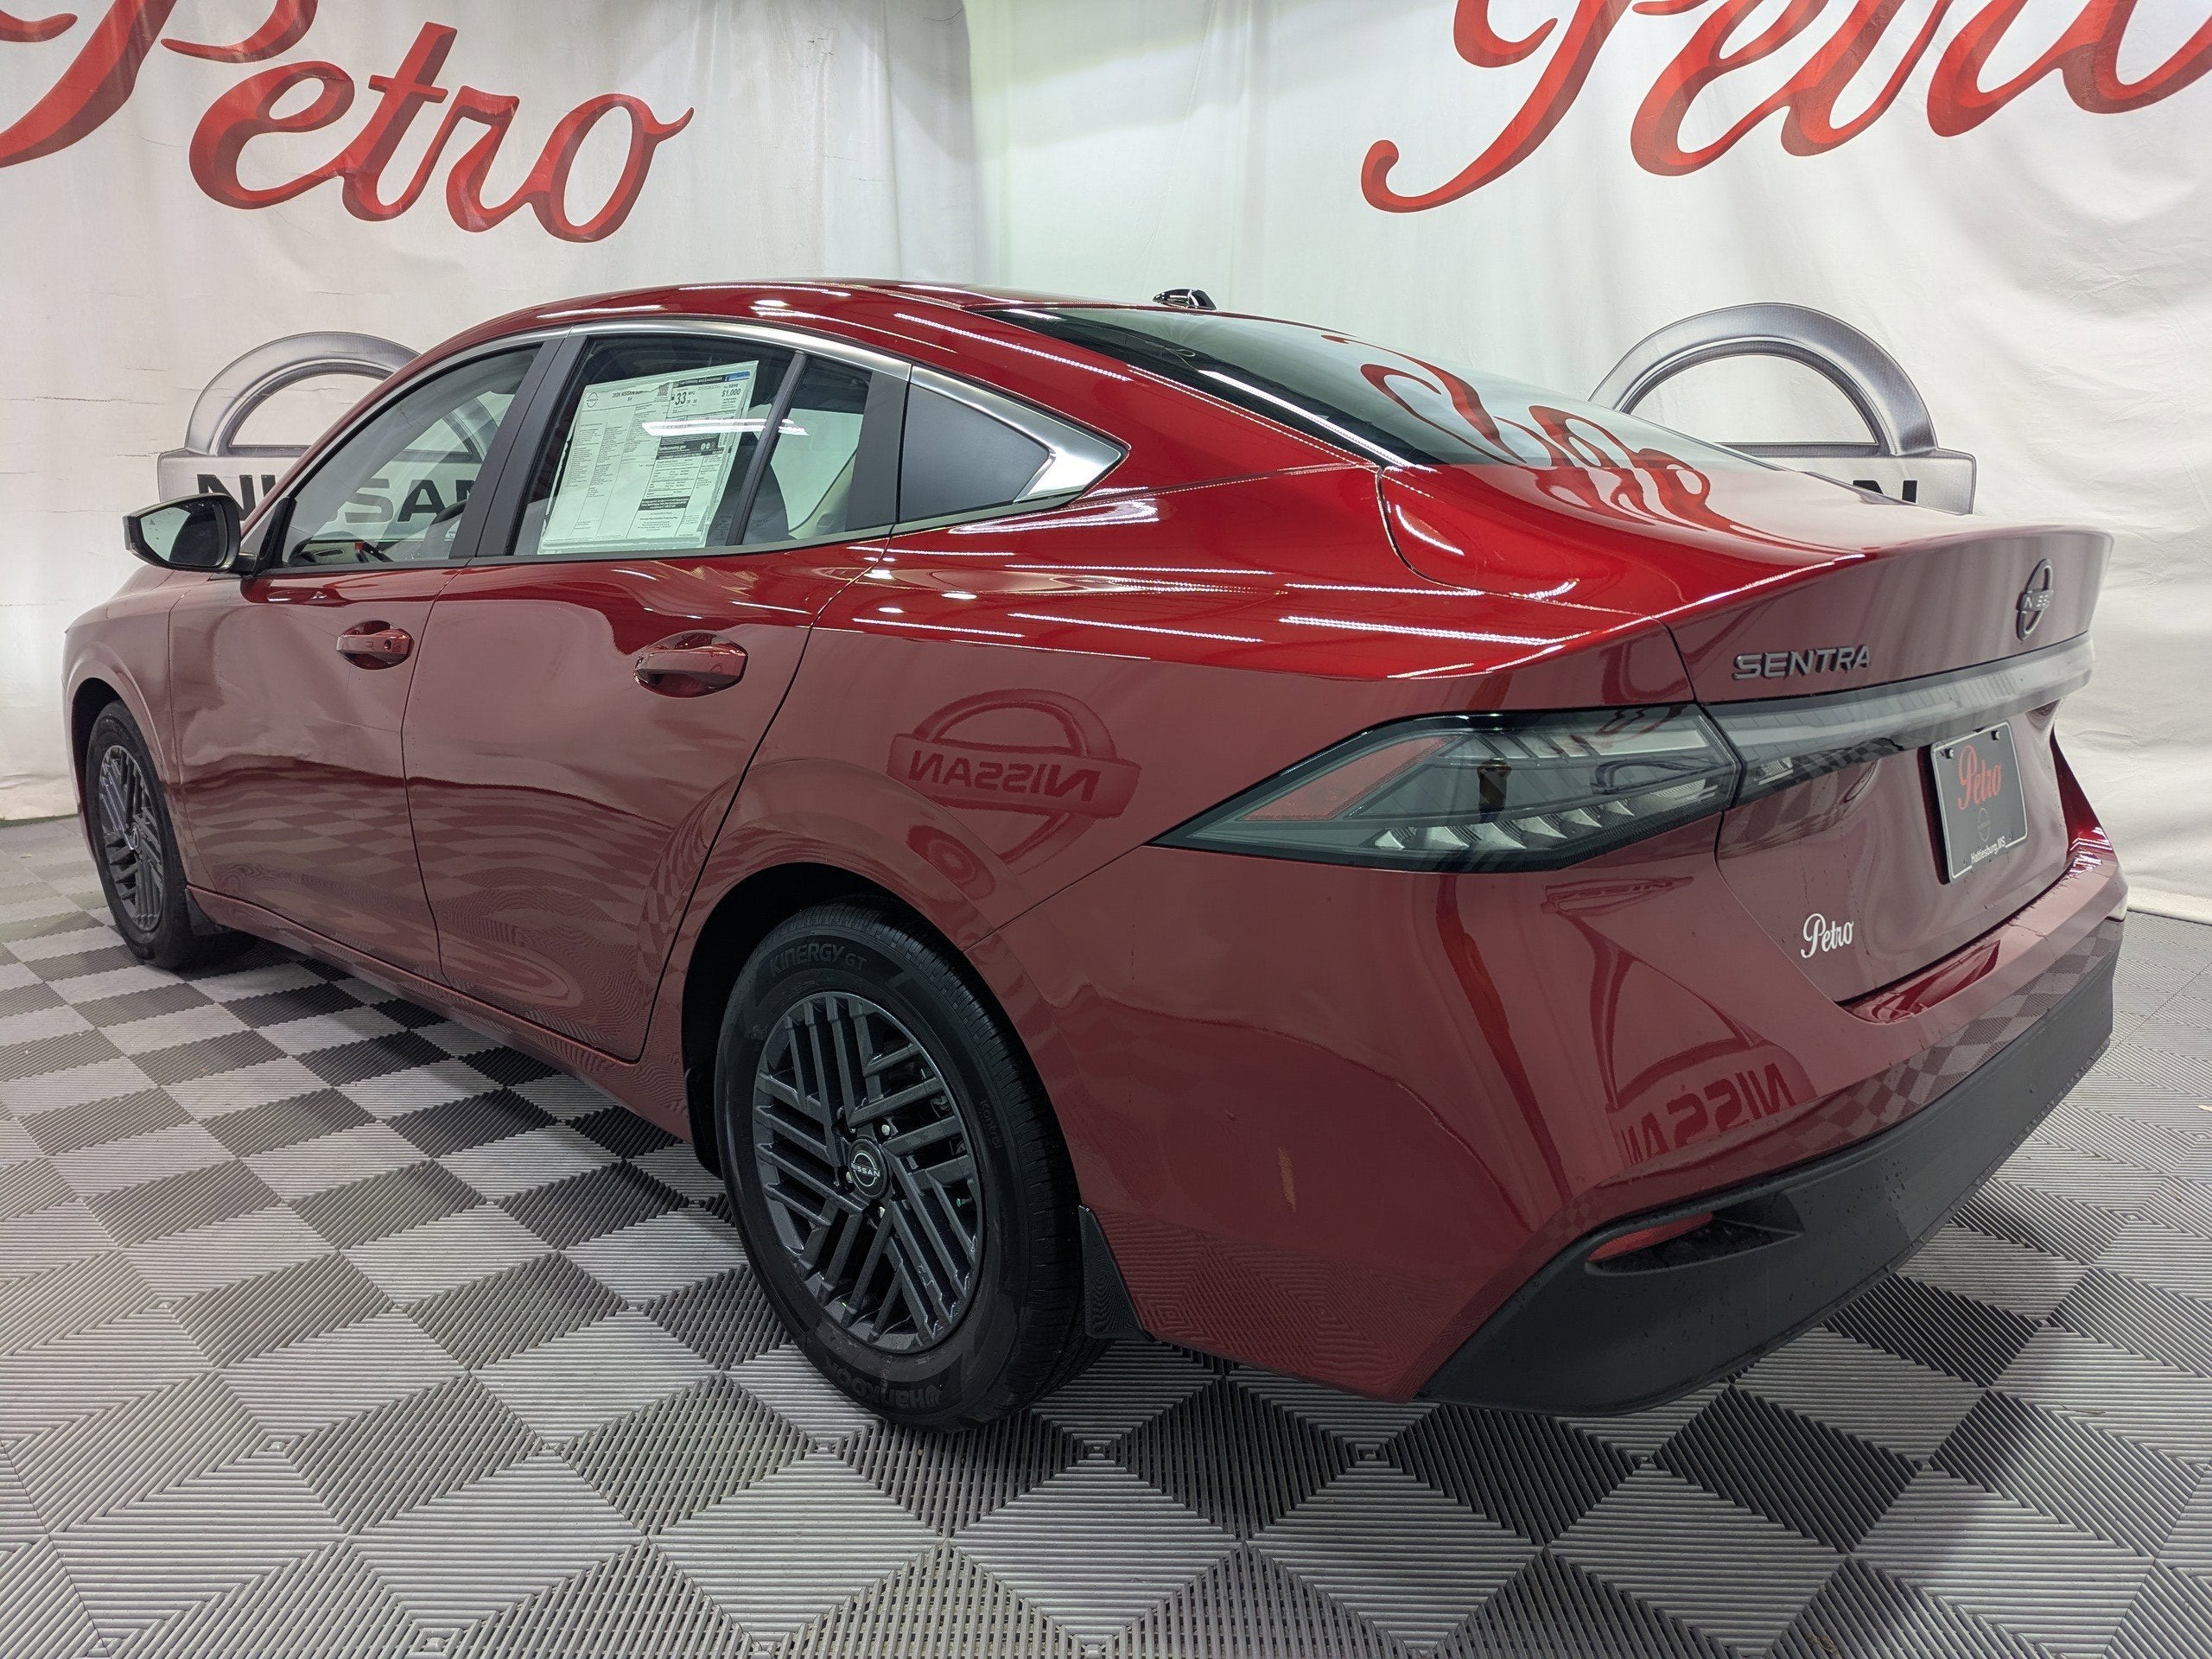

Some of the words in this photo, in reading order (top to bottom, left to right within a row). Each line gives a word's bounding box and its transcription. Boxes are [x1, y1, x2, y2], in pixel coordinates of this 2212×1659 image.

[675, 391, 687, 405] 33
[1732, 645, 1872, 680] SENTRA
[1957, 744, 2002, 810] Petro
[1800, 912, 1854, 958] Petro
[851, 1162, 880, 1178] NISSAN
